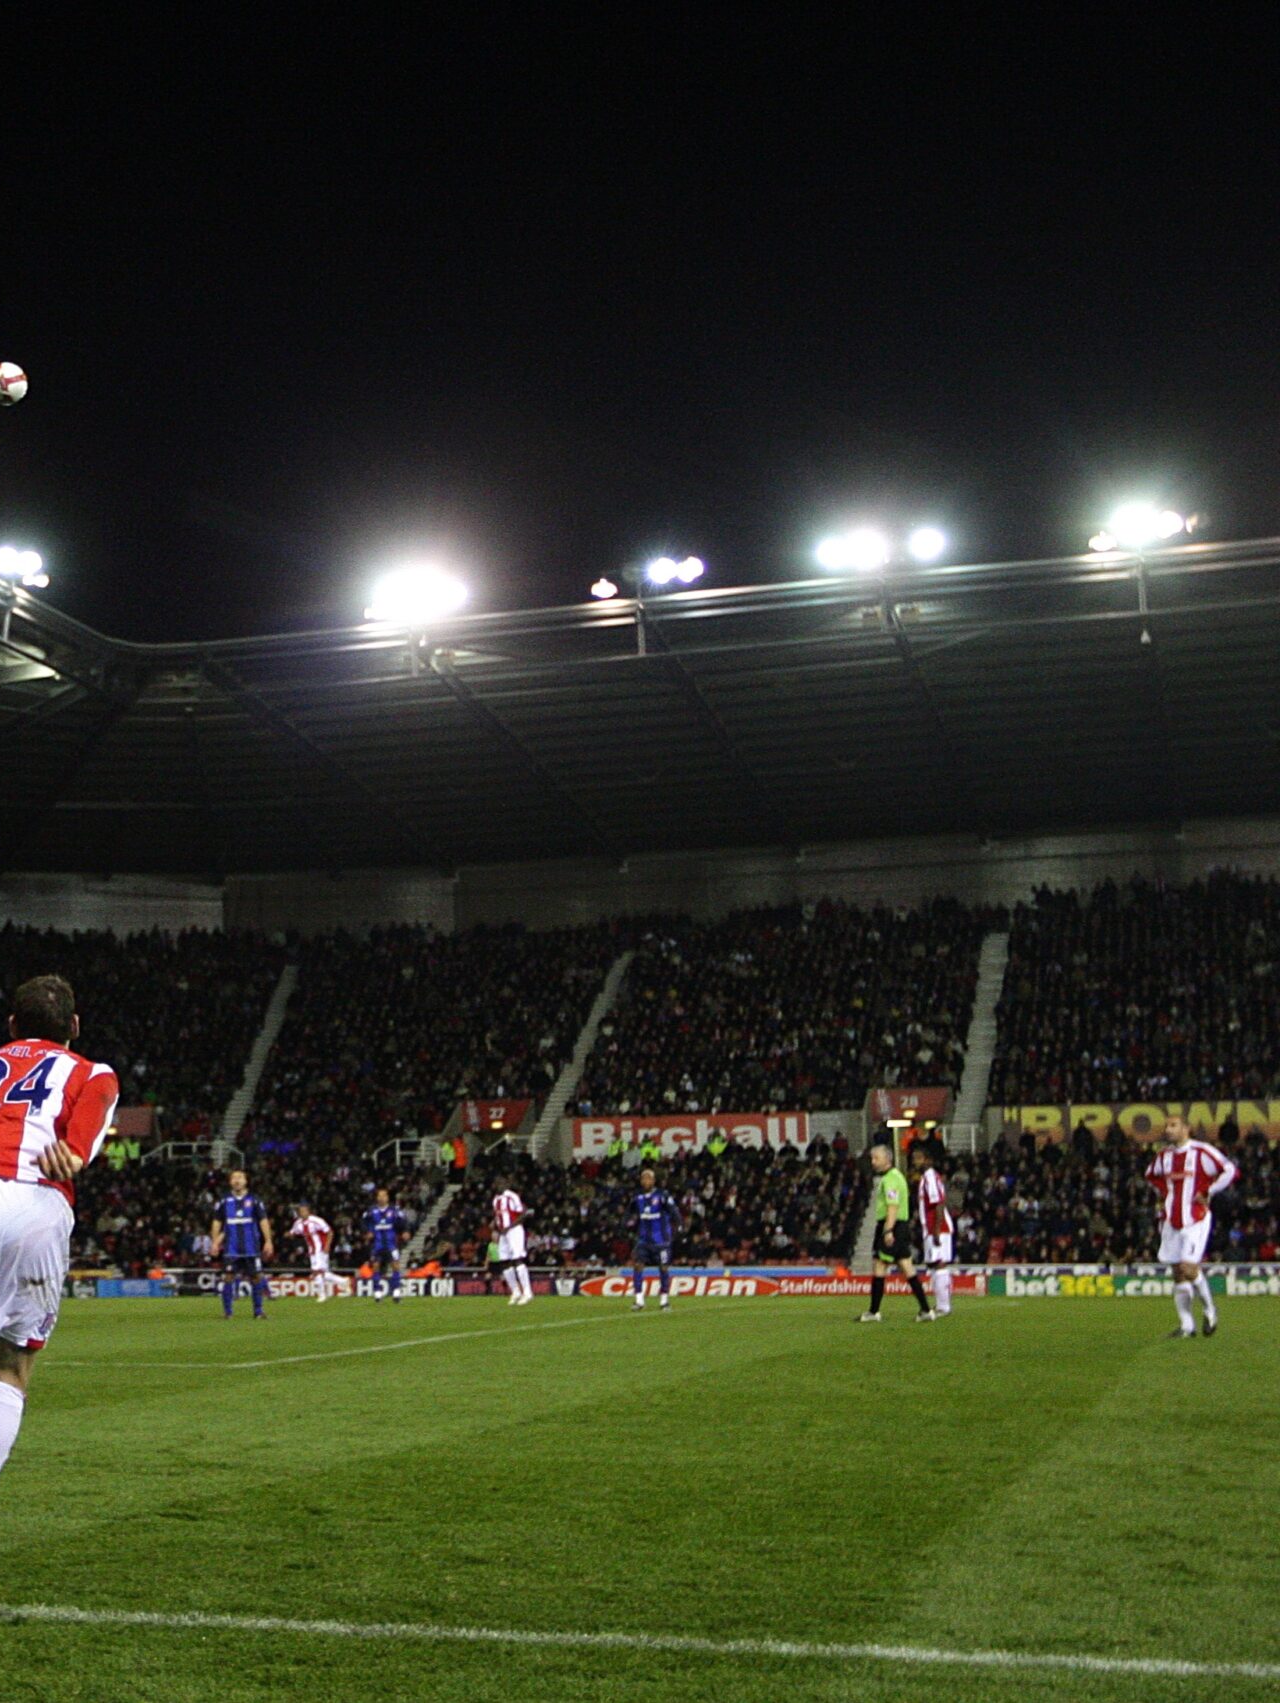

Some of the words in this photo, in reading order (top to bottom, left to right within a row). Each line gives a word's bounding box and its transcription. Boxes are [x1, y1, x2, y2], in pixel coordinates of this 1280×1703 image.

[488, 1106, 506, 1120] 27
[581, 1116, 807, 1157] Birchall
[431, 1278, 454, 1297] ON
[780, 1278, 872, 1295] Staffordshire
